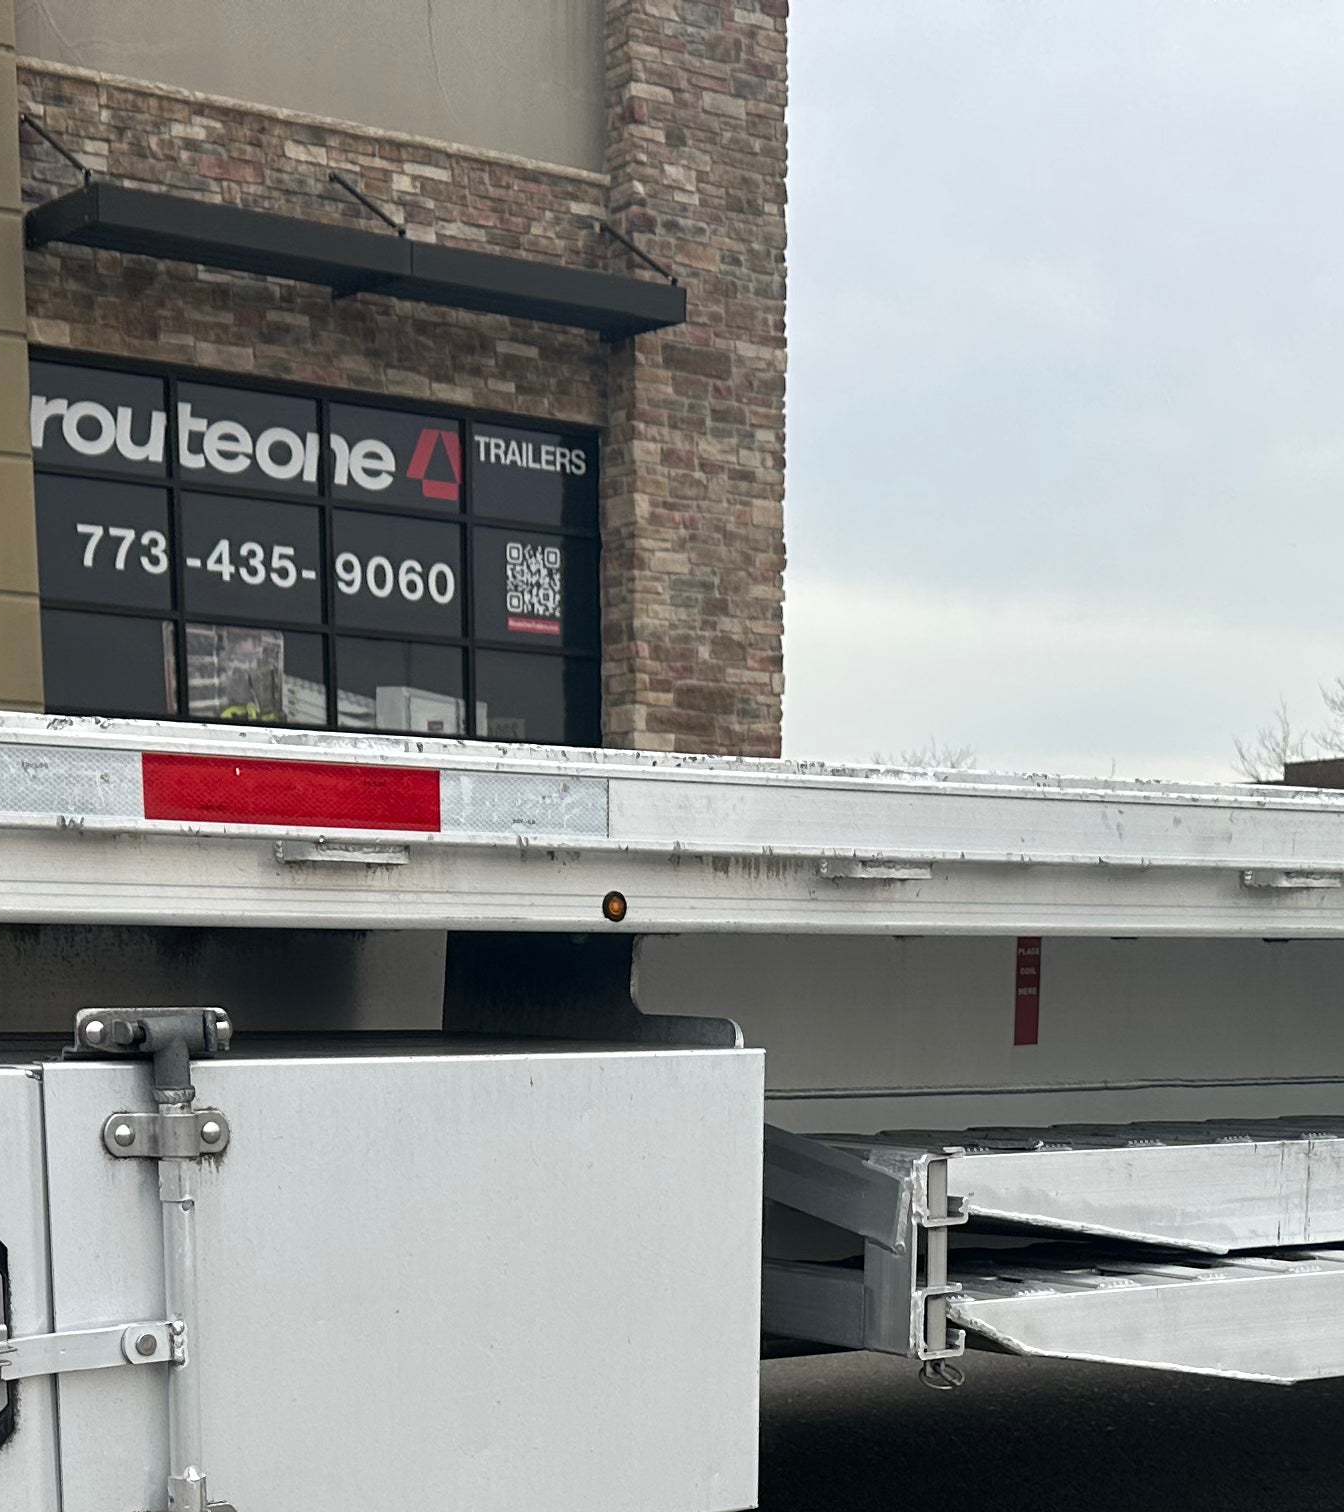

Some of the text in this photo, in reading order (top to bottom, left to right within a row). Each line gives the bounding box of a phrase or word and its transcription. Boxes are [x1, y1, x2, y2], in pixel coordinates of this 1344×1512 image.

[29, 395, 396, 490] routeone
[474, 434, 586, 475] TRAILERS
[76, 523, 455, 605] 773-435-9060
[1018, 947, 1040, 956] PLACE
[1020, 967, 1037, 975] COIL
[1018, 987, 1037, 995] HERE
